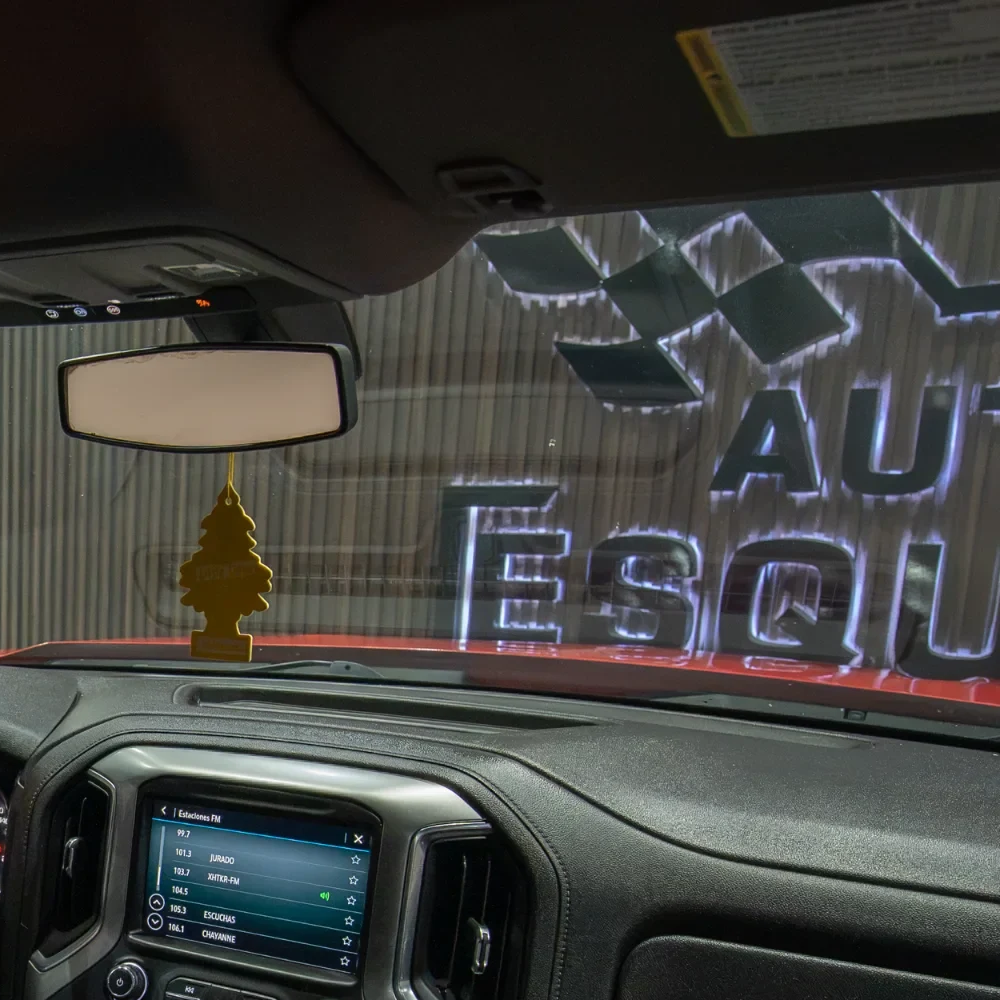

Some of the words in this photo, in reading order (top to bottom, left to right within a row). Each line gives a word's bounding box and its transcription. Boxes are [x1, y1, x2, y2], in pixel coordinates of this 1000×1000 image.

[708, 385, 1000, 497] AU
[178, 809, 210, 822] Estaciones
[210, 814, 221, 823] FM
[177, 829, 191, 838] 99.7
[175, 848, 192, 858] 101.3
[209, 853, 235, 865] JURADO
[173, 867, 191, 877] 103.7
[171, 886, 189, 896] 104.5
[170, 904, 187, 915] 105.3
[203, 910, 236, 924] ESCUCHAS
[168, 923, 185, 933] 106.1
[202, 929, 236, 944] CHAYANNE
